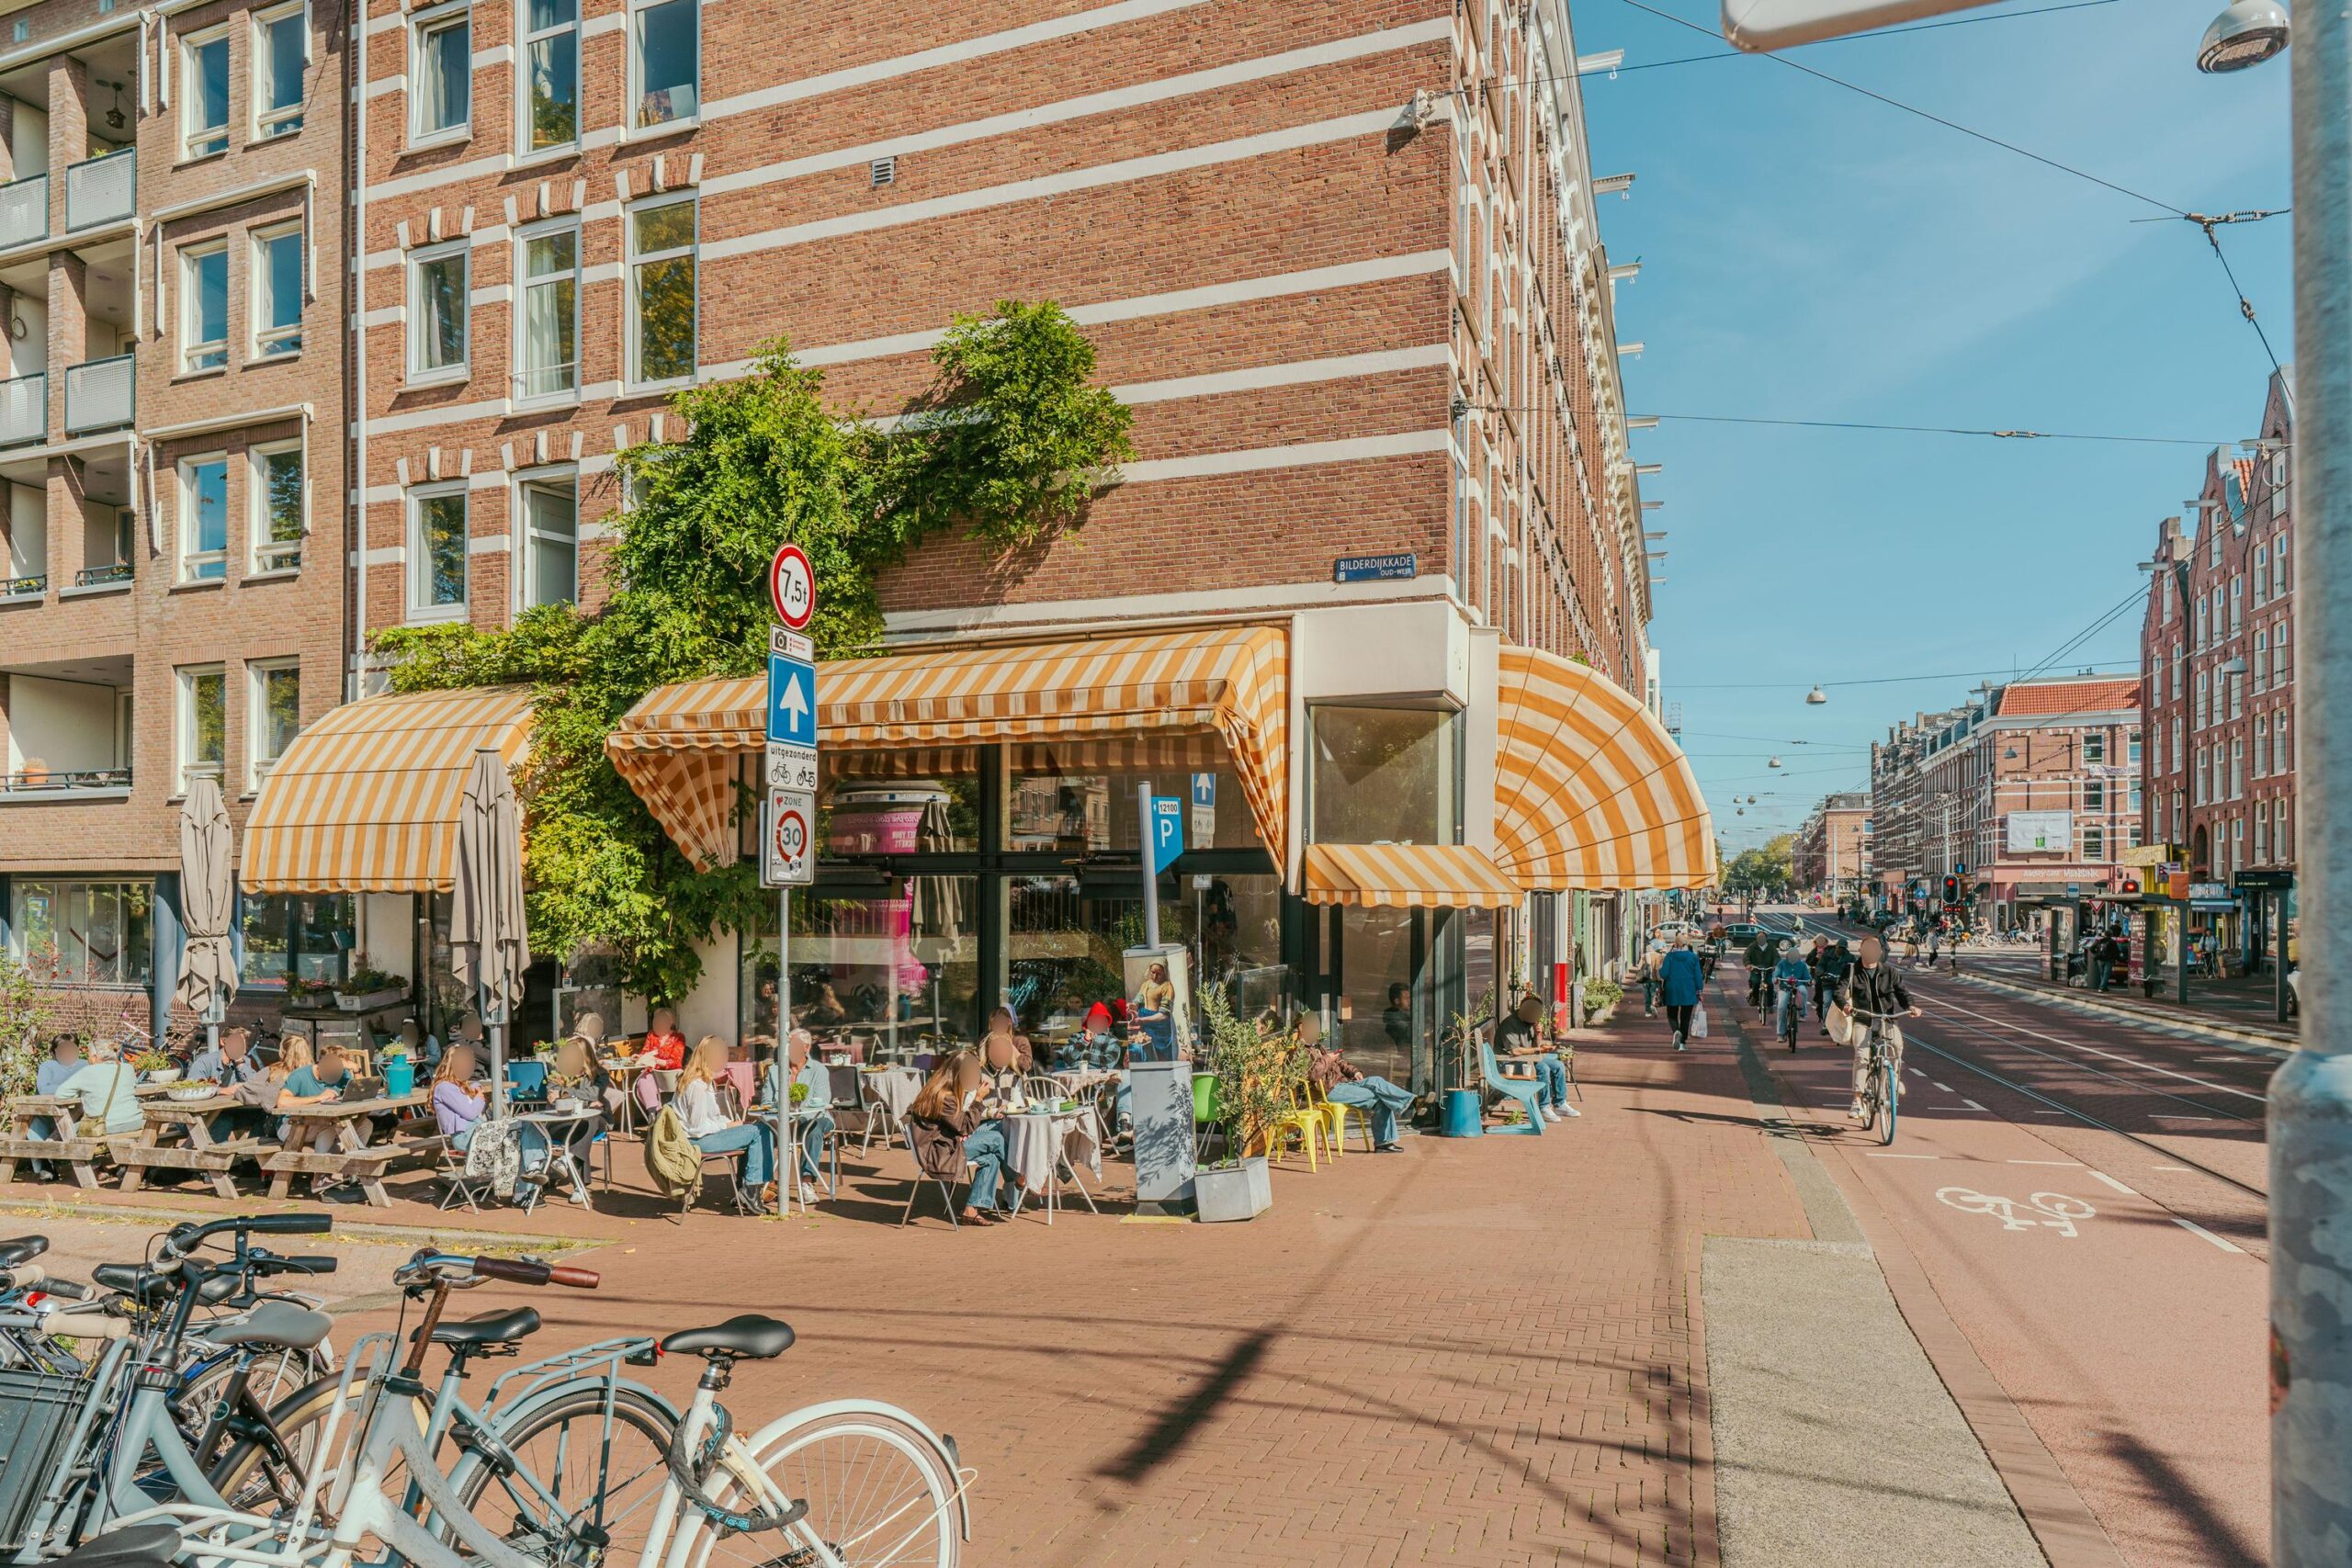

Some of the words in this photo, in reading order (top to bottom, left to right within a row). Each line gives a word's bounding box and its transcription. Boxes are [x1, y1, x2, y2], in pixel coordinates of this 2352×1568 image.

[1340, 556, 1412, 570] BILDERDIJKKADE
[770, 745, 817, 762] uitgezonderd
[784, 796, 803, 807] ZONE
[1159, 803, 1178, 813] 12100
[782, 826, 802, 847] 30
[1160, 818, 1173, 848] P
